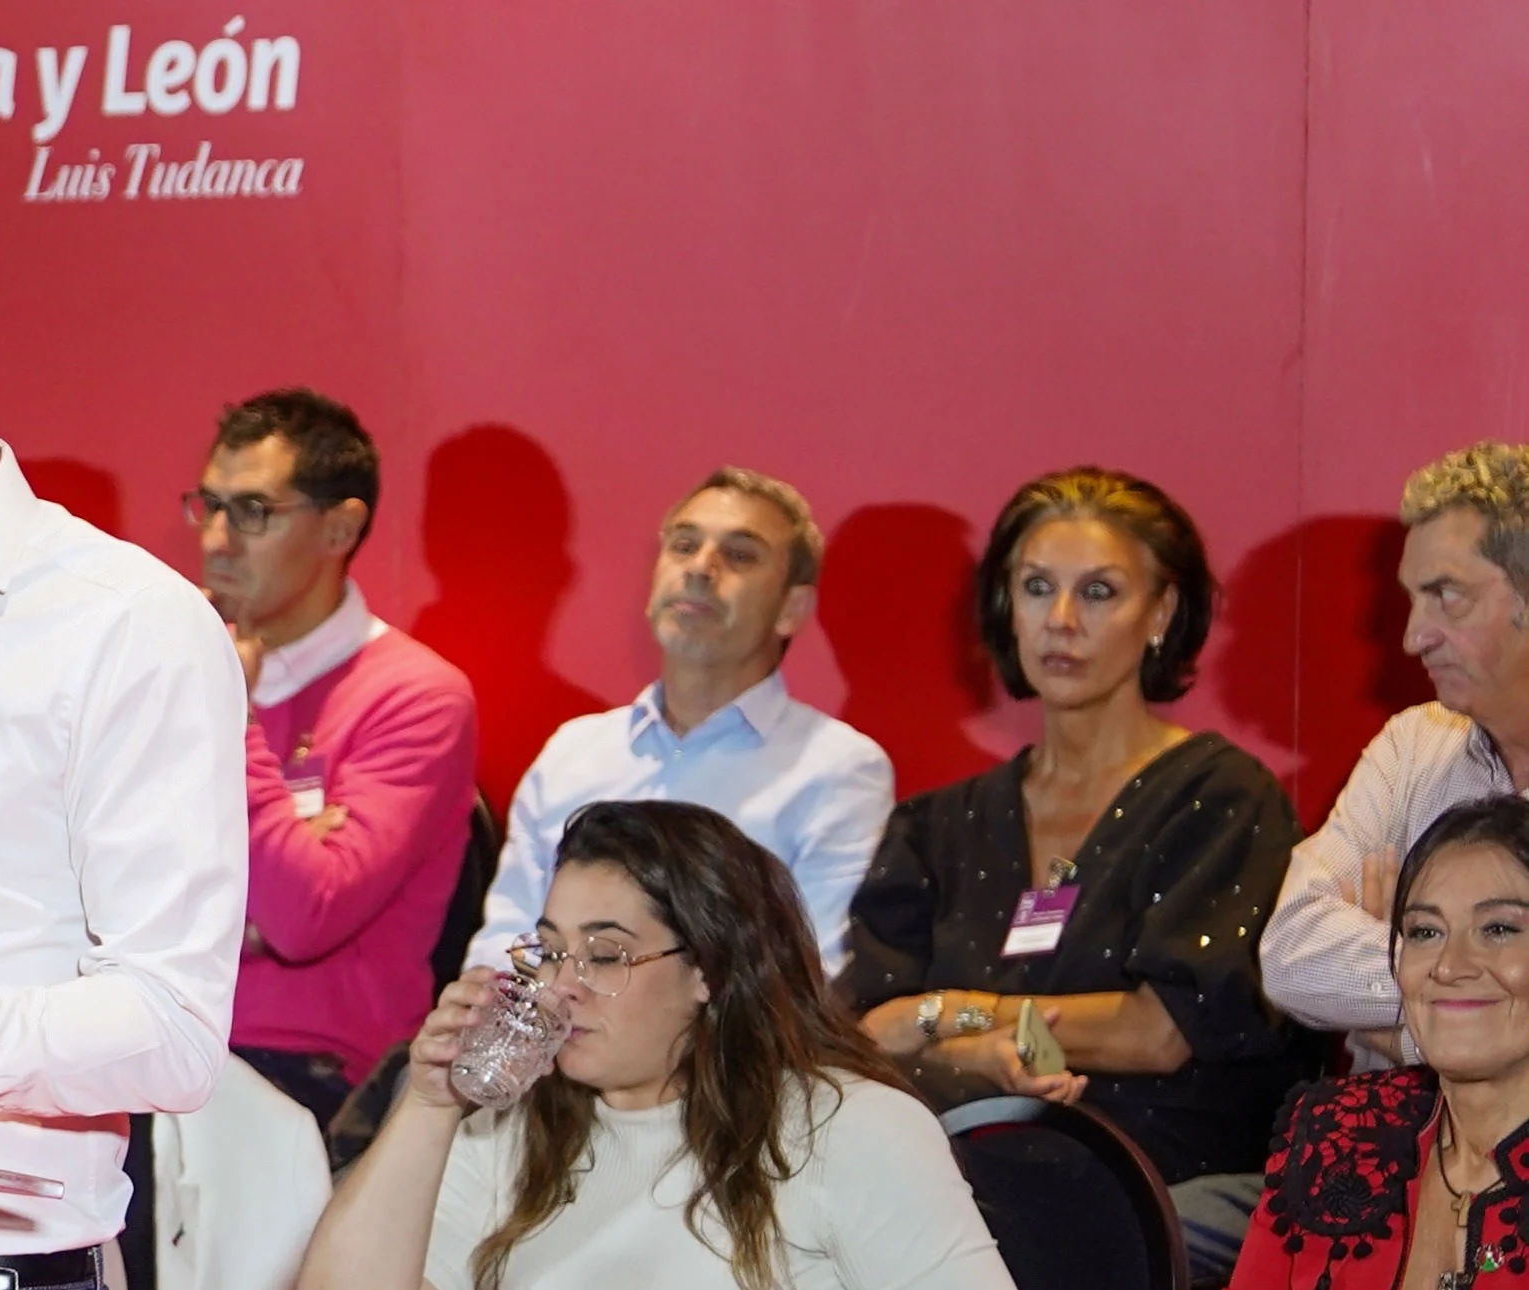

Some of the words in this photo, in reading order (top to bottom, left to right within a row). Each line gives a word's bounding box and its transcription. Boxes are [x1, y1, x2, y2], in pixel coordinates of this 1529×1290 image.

[32, 45, 89, 144] y
[102, 15, 302, 117] León
[23, 146, 114, 202] Luis
[124, 141, 305, 199] Tudanca
